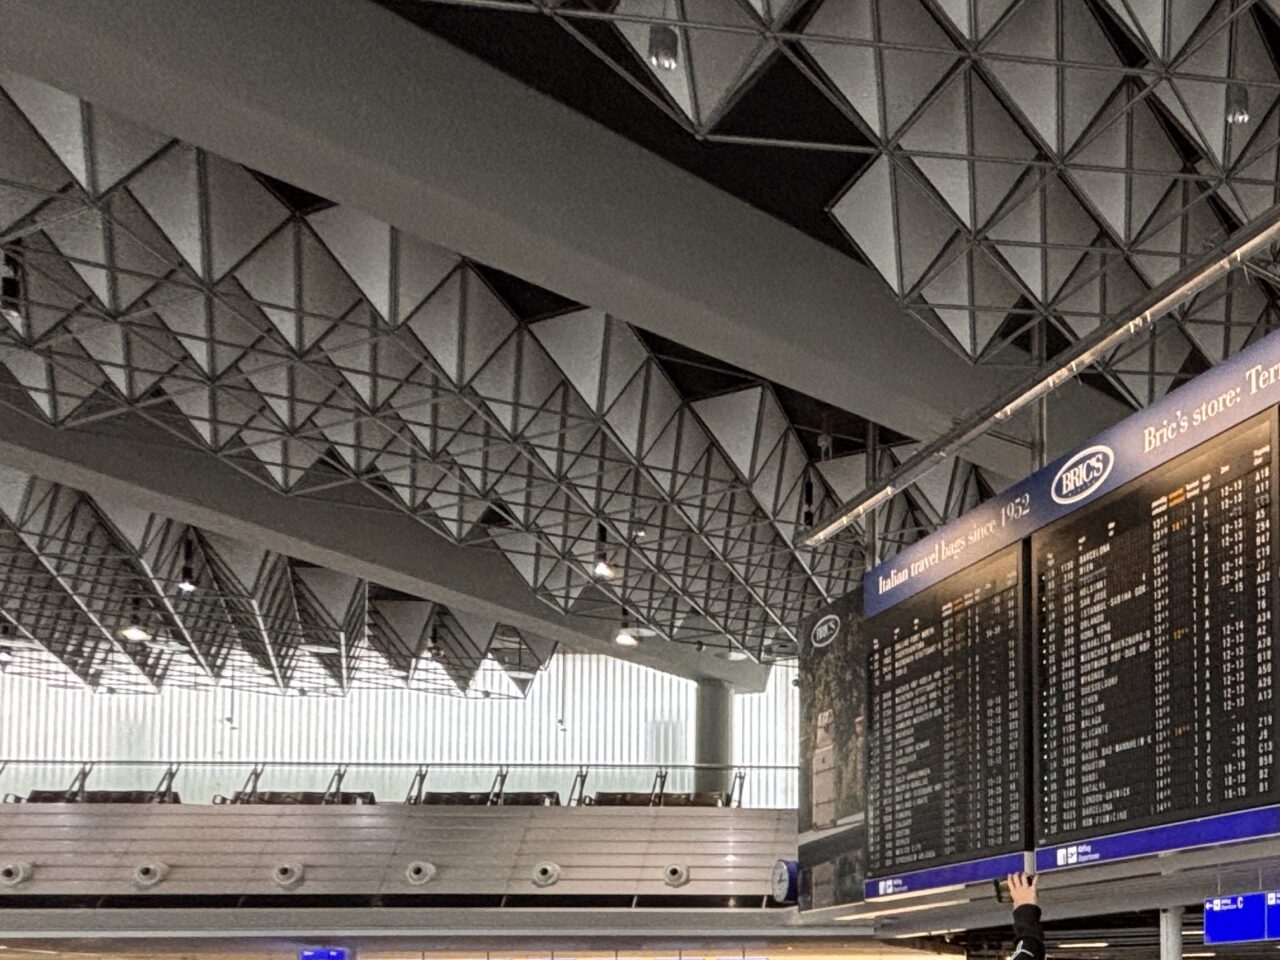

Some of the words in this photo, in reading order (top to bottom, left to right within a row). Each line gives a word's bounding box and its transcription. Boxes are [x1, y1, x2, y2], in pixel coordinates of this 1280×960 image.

[1143, 410, 1188, 454] Bric's
[1192, 386, 1242, 428] store:
[878, 564, 909, 595] Italian
[910, 543, 939, 577] travel
[941, 532, 966, 561] bags
[968, 518, 998, 544] since
[999, 492, 1031, 528] 1952
[1237, 897, 1243, 909] C
